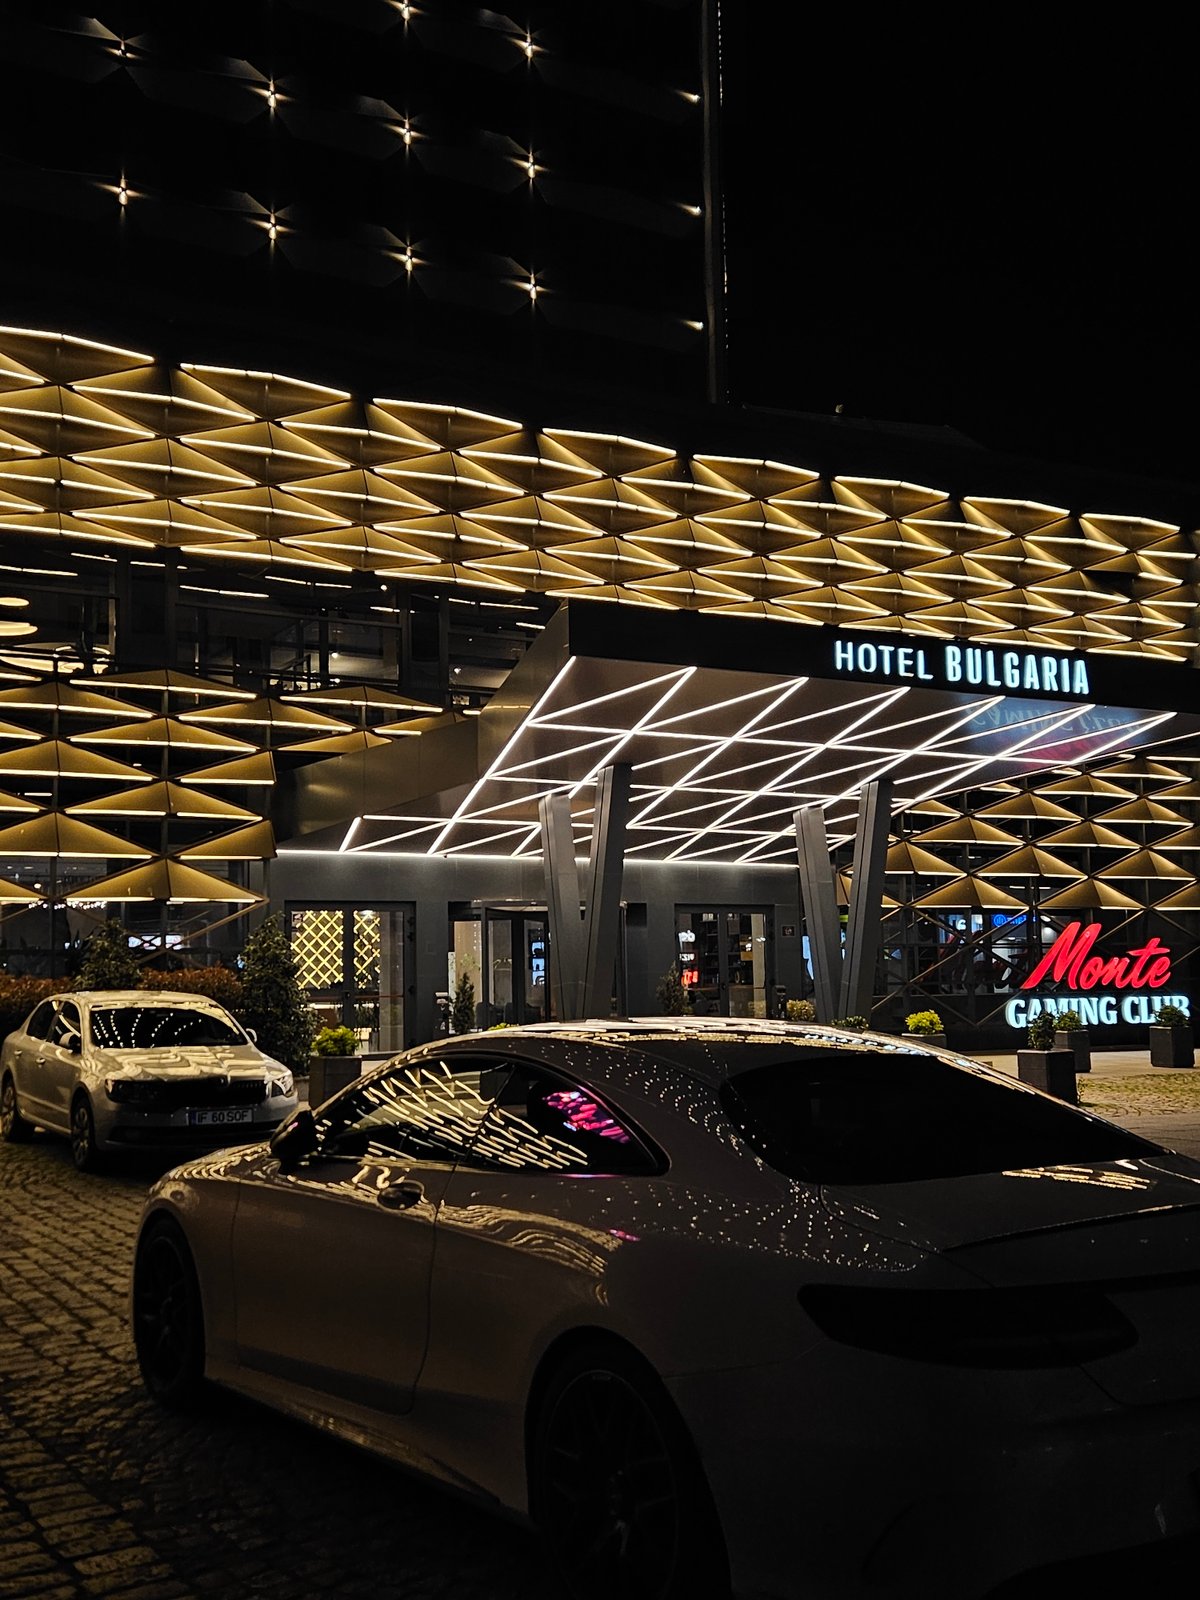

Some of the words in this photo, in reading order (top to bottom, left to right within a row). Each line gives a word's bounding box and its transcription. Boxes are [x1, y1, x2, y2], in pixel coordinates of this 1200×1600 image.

[834, 640, 934, 680] HOTEL
[945, 645, 1089, 695] BULGARIA
[1020, 921, 1172, 990] Monte
[197, 1111, 208, 1123] IF
[211, 1111, 225, 1123] 60
[226, 1109, 249, 1122] SOF
